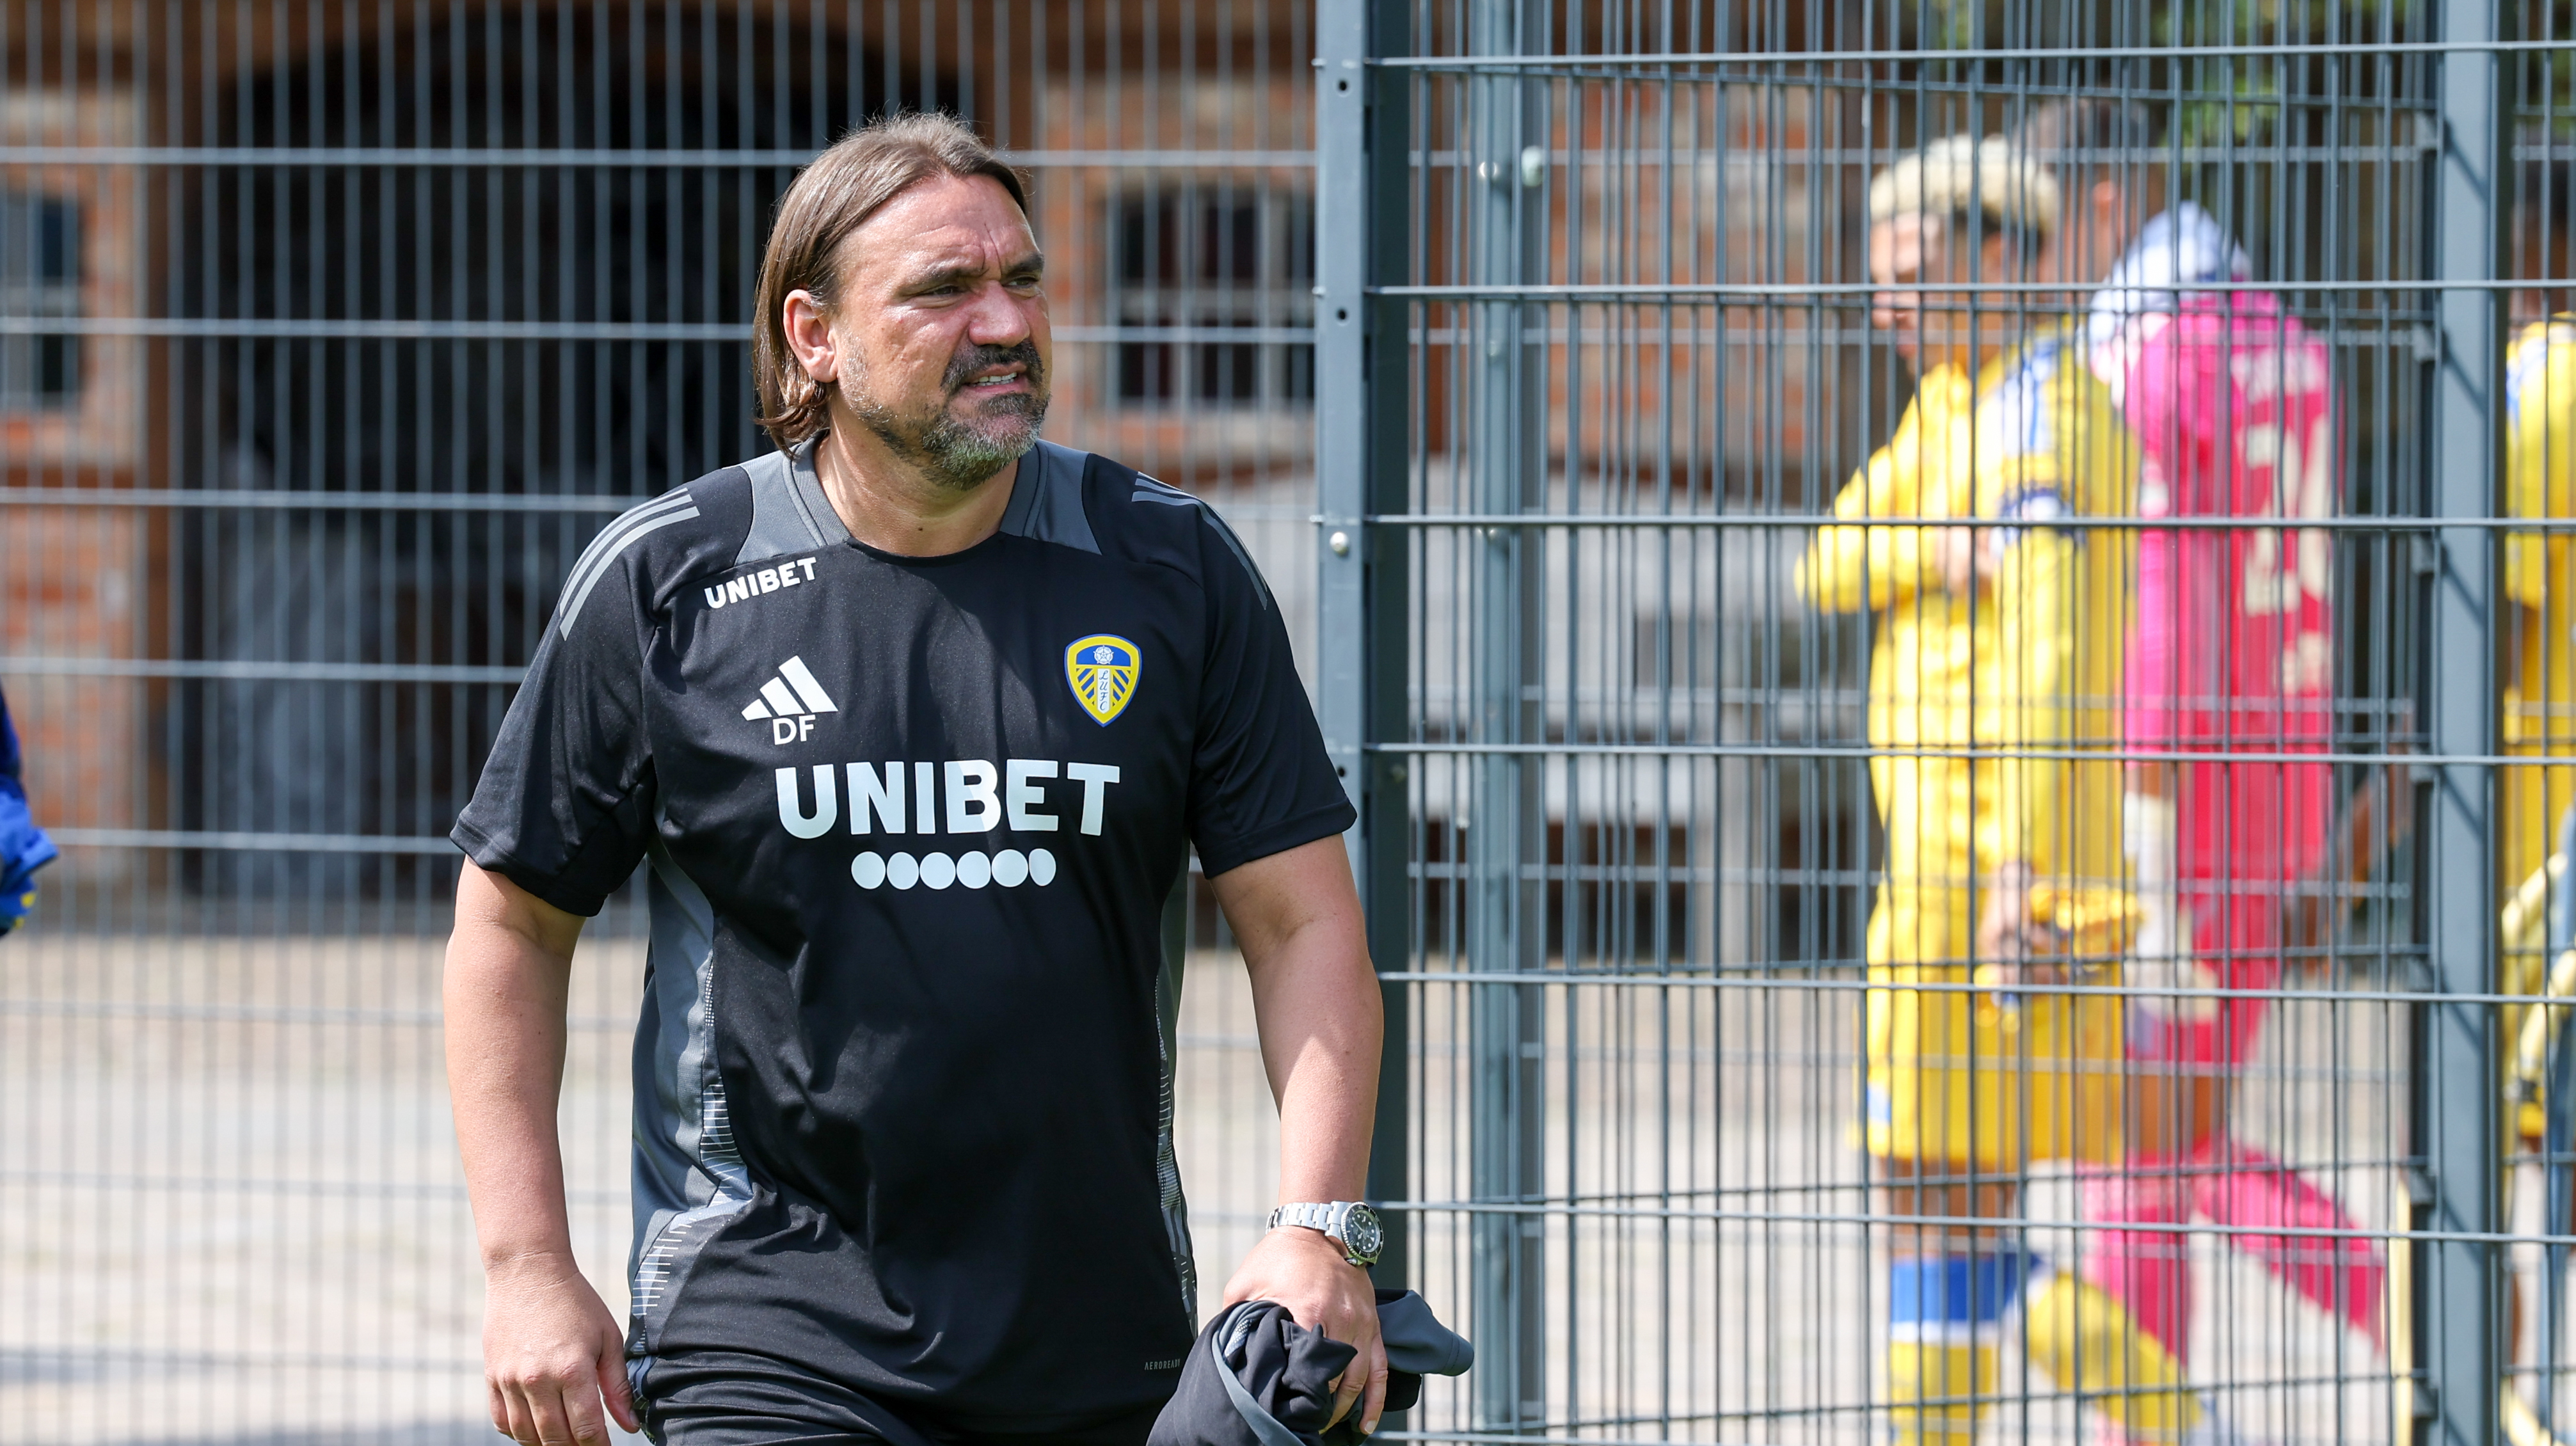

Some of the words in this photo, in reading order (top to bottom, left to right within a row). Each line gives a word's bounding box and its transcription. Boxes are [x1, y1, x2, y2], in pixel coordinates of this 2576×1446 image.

[704, 557, 817, 610] UNIBET
[772, 715, 816, 745] DF
[775, 759, 1120, 839] UNIBET
[1144, 1358, 1181, 1371] AEROREADY
